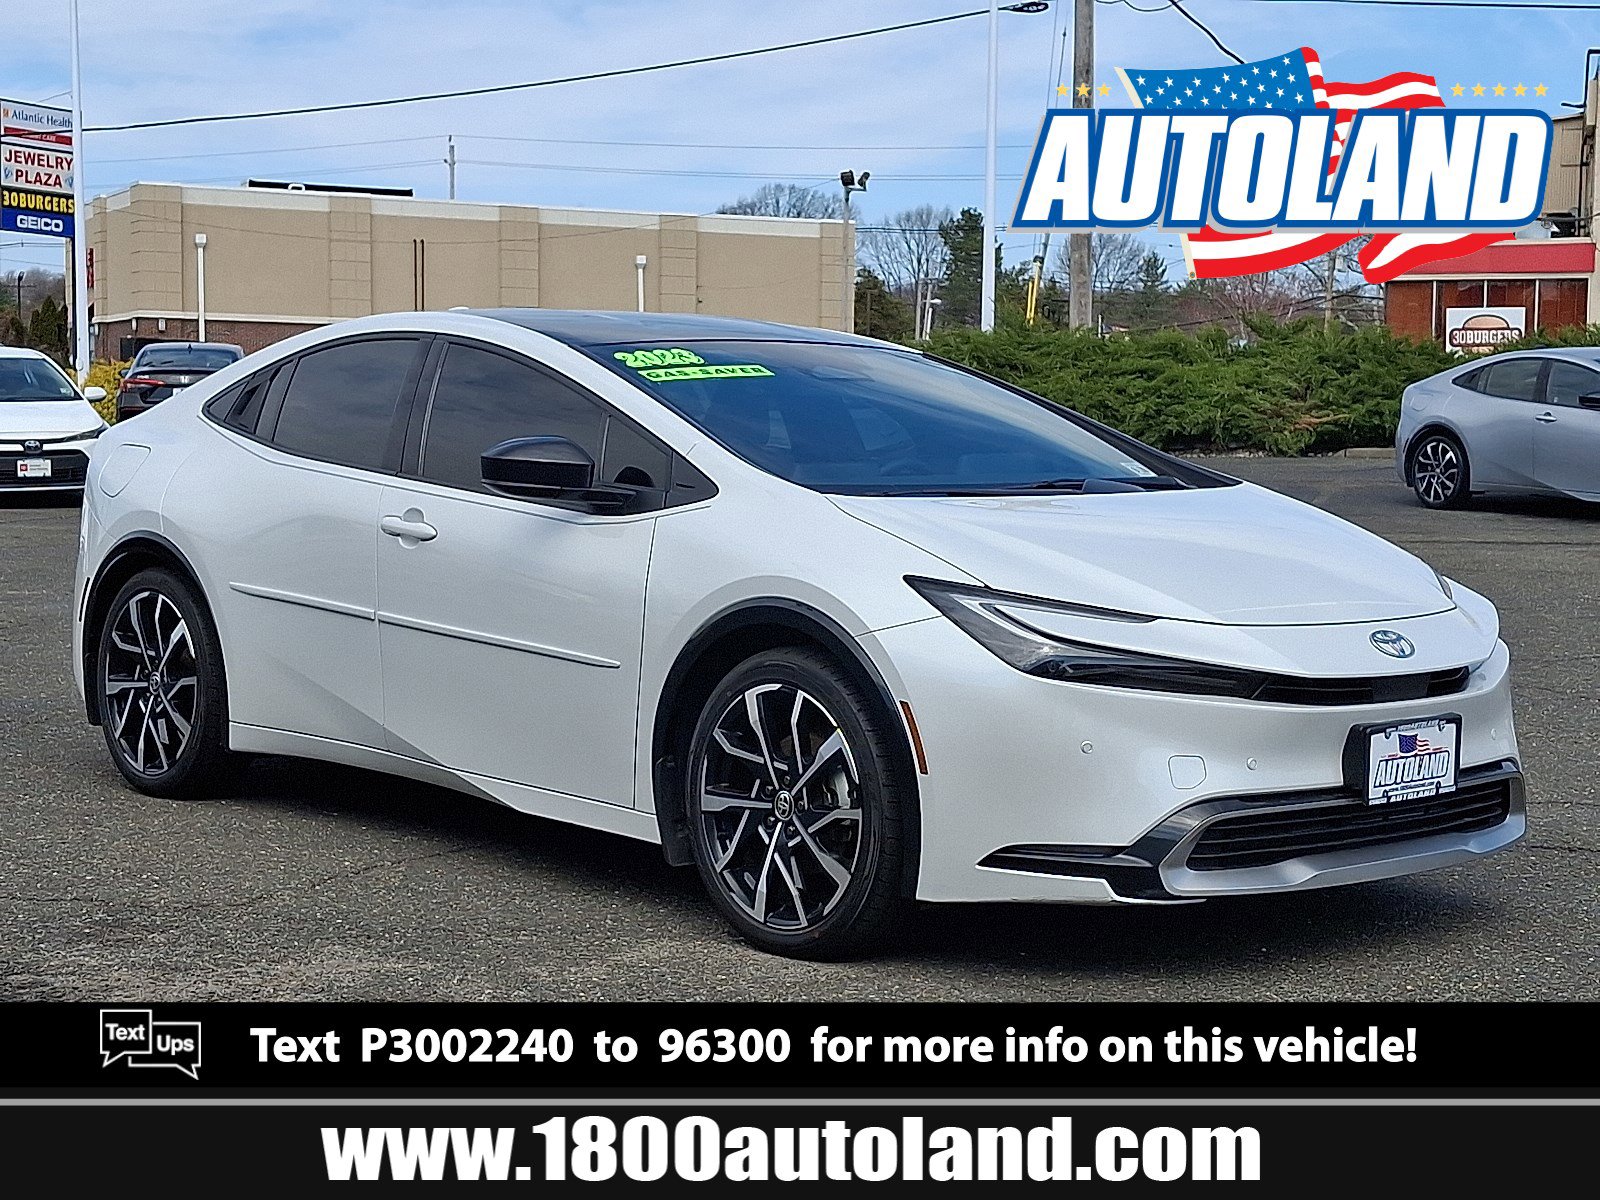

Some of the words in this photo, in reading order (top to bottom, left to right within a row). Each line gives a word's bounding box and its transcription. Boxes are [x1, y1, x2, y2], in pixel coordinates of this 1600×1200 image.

[12, 109, 43, 124] Atlantic
[47, 113, 73, 128] Health
[4, 149, 73, 171] JEWELRY
[15, 169, 62, 188] PLAZA
[3, 191, 74, 214] 30BURGERS
[17, 215, 63, 232] GEICO
[646, 366, 764, 380] GAS-SAVER
[1374, 751, 1450, 788] AUTOLAND
[1389, 789, 1437, 802] AUTOLAND
